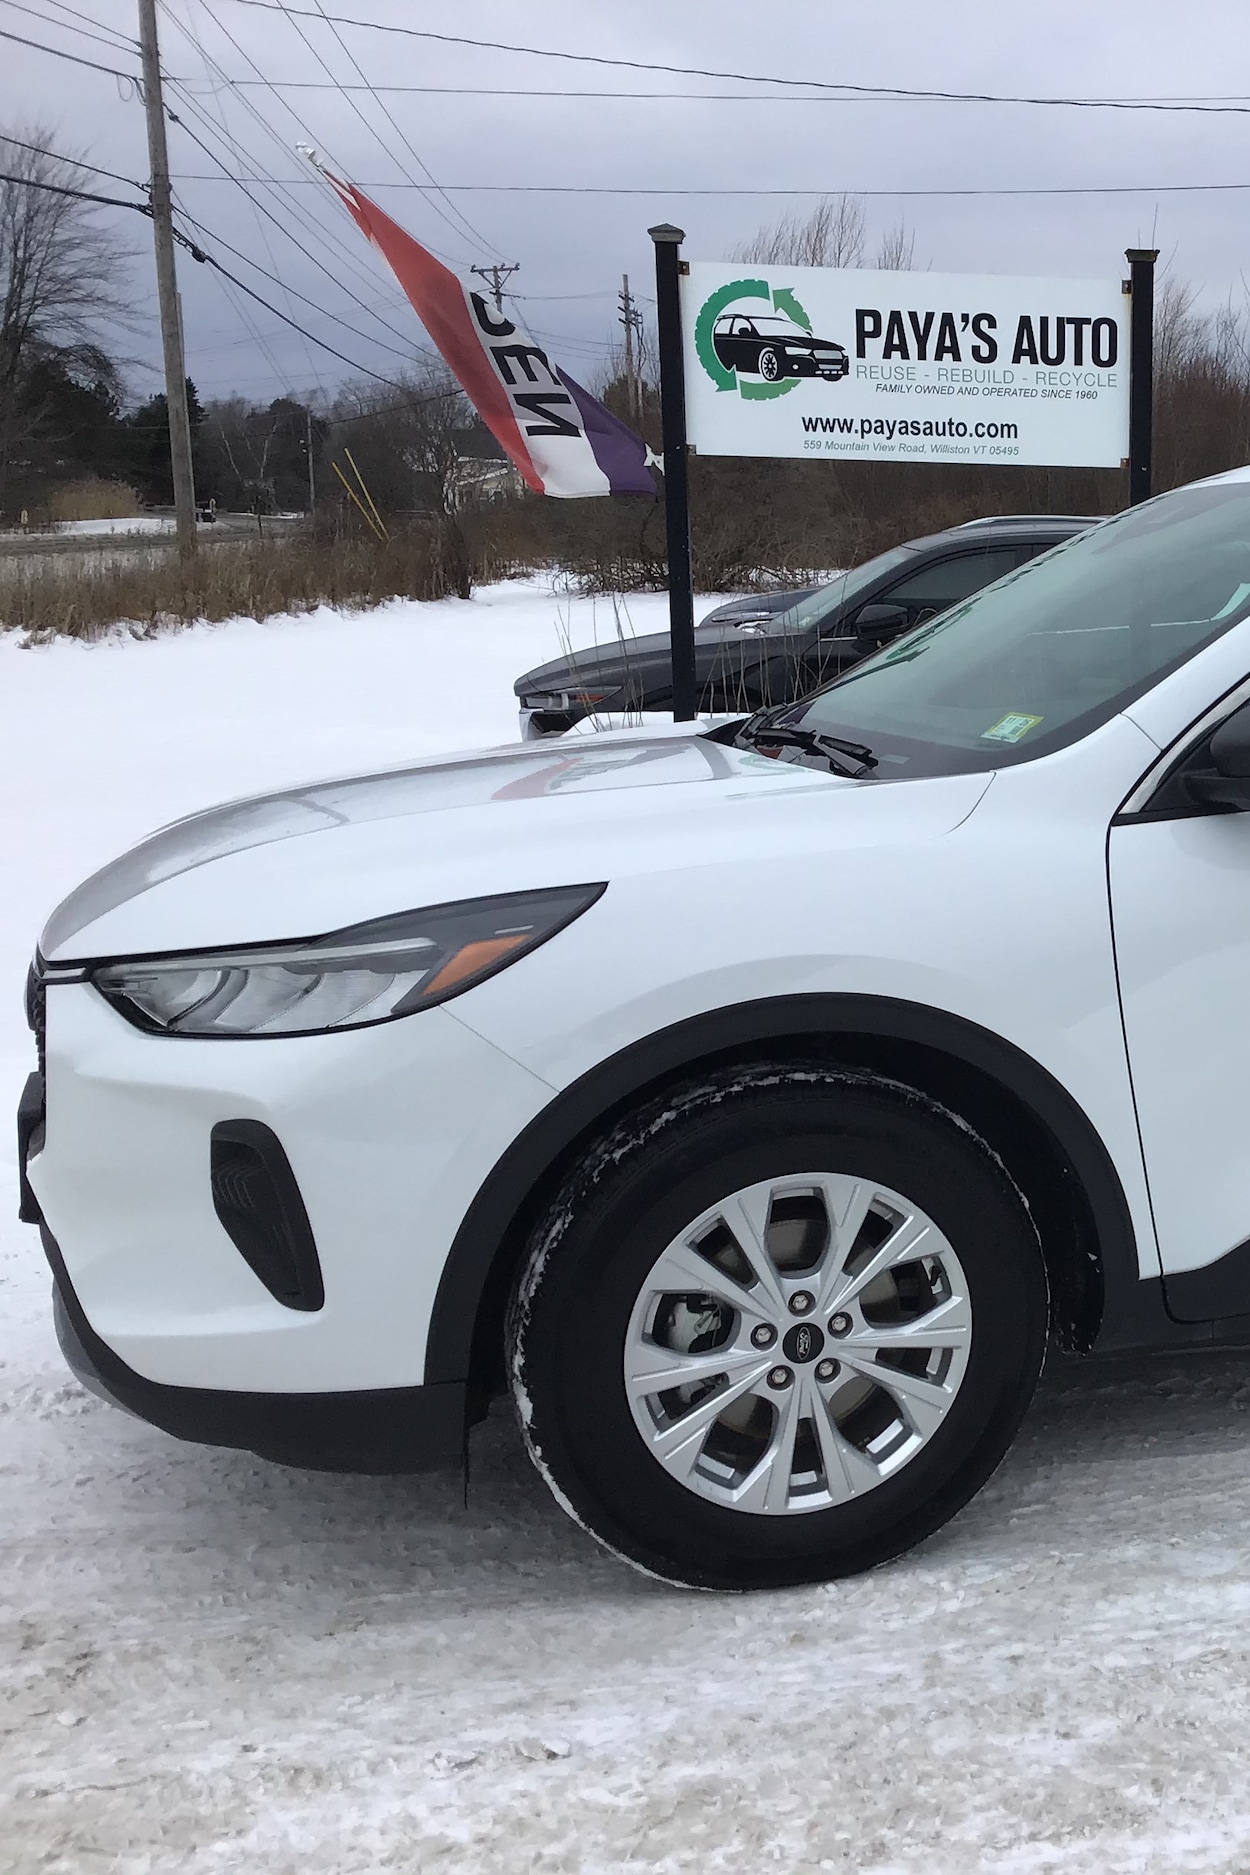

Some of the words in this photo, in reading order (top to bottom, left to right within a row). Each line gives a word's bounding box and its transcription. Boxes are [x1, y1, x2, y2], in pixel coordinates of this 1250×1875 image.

[855, 309, 998, 364] PAYA'S
[1011, 315, 1118, 368] AUTO
[856, 365, 917, 381] REUSE
[938, 367, 1015, 385] REBUILD
[1036, 371, 1118, 388] RECYCLE
[876, 384, 914, 394] FAMILY
[915, 385, 956, 395] OWNED
[957, 387, 979, 396] AND
[983, 388, 1039, 398] OPERATED
[1041, 389, 1072, 399] SINCE
[1075, 390, 1098, 400] 1960
[801, 417, 1018, 440] www.payasauto.com
[803, 440, 822, 450] 559
[825, 441, 870, 452] Mountain
[873, 443, 896, 452] View
[899, 443, 927, 454] Road,
[930, 444, 970, 455] Williston
[974, 446, 987, 455] VT
[990, 446, 1019, 456] 05495
